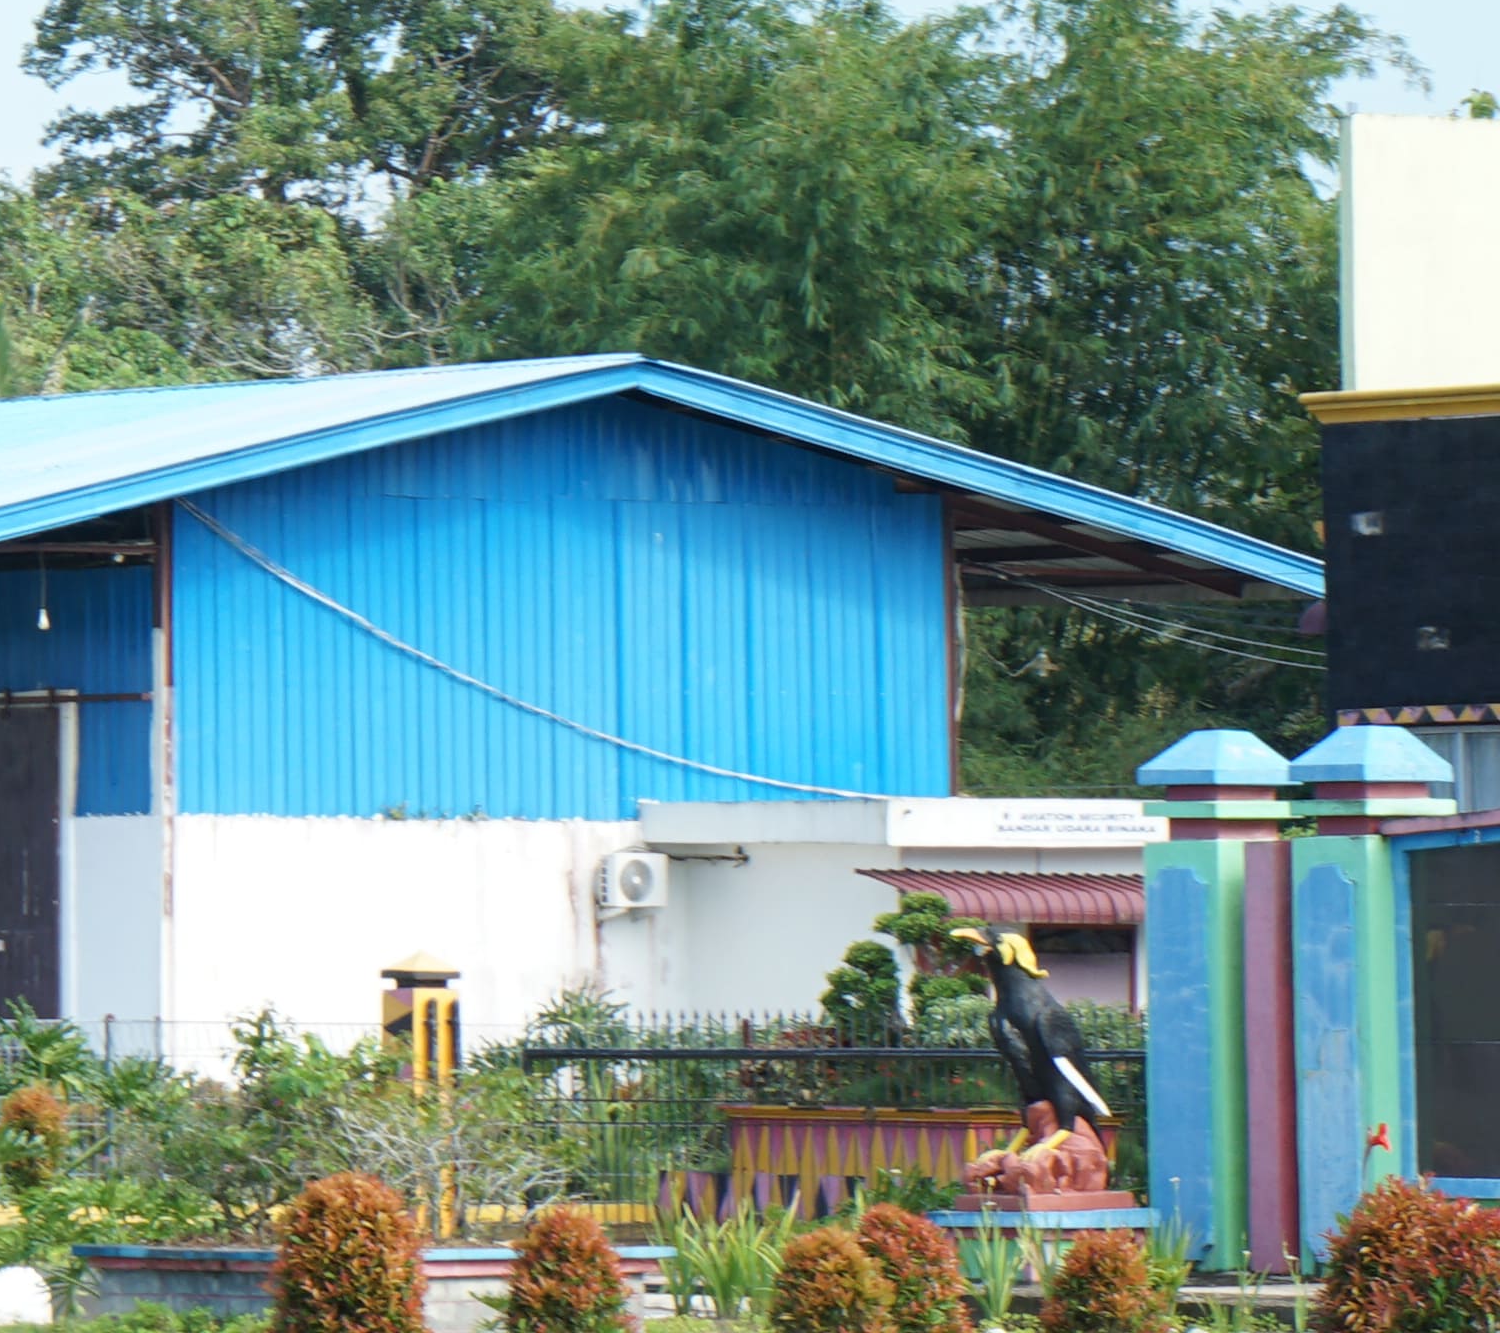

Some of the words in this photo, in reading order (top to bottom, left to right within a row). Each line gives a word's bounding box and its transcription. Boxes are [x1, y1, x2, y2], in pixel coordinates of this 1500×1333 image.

[1021, 813, 1074, 821] AVIATION
[1079, 813, 1134, 821] SECURITY
[998, 824, 1051, 833] BANDAR
[1056, 825, 1100, 833] UDARA
